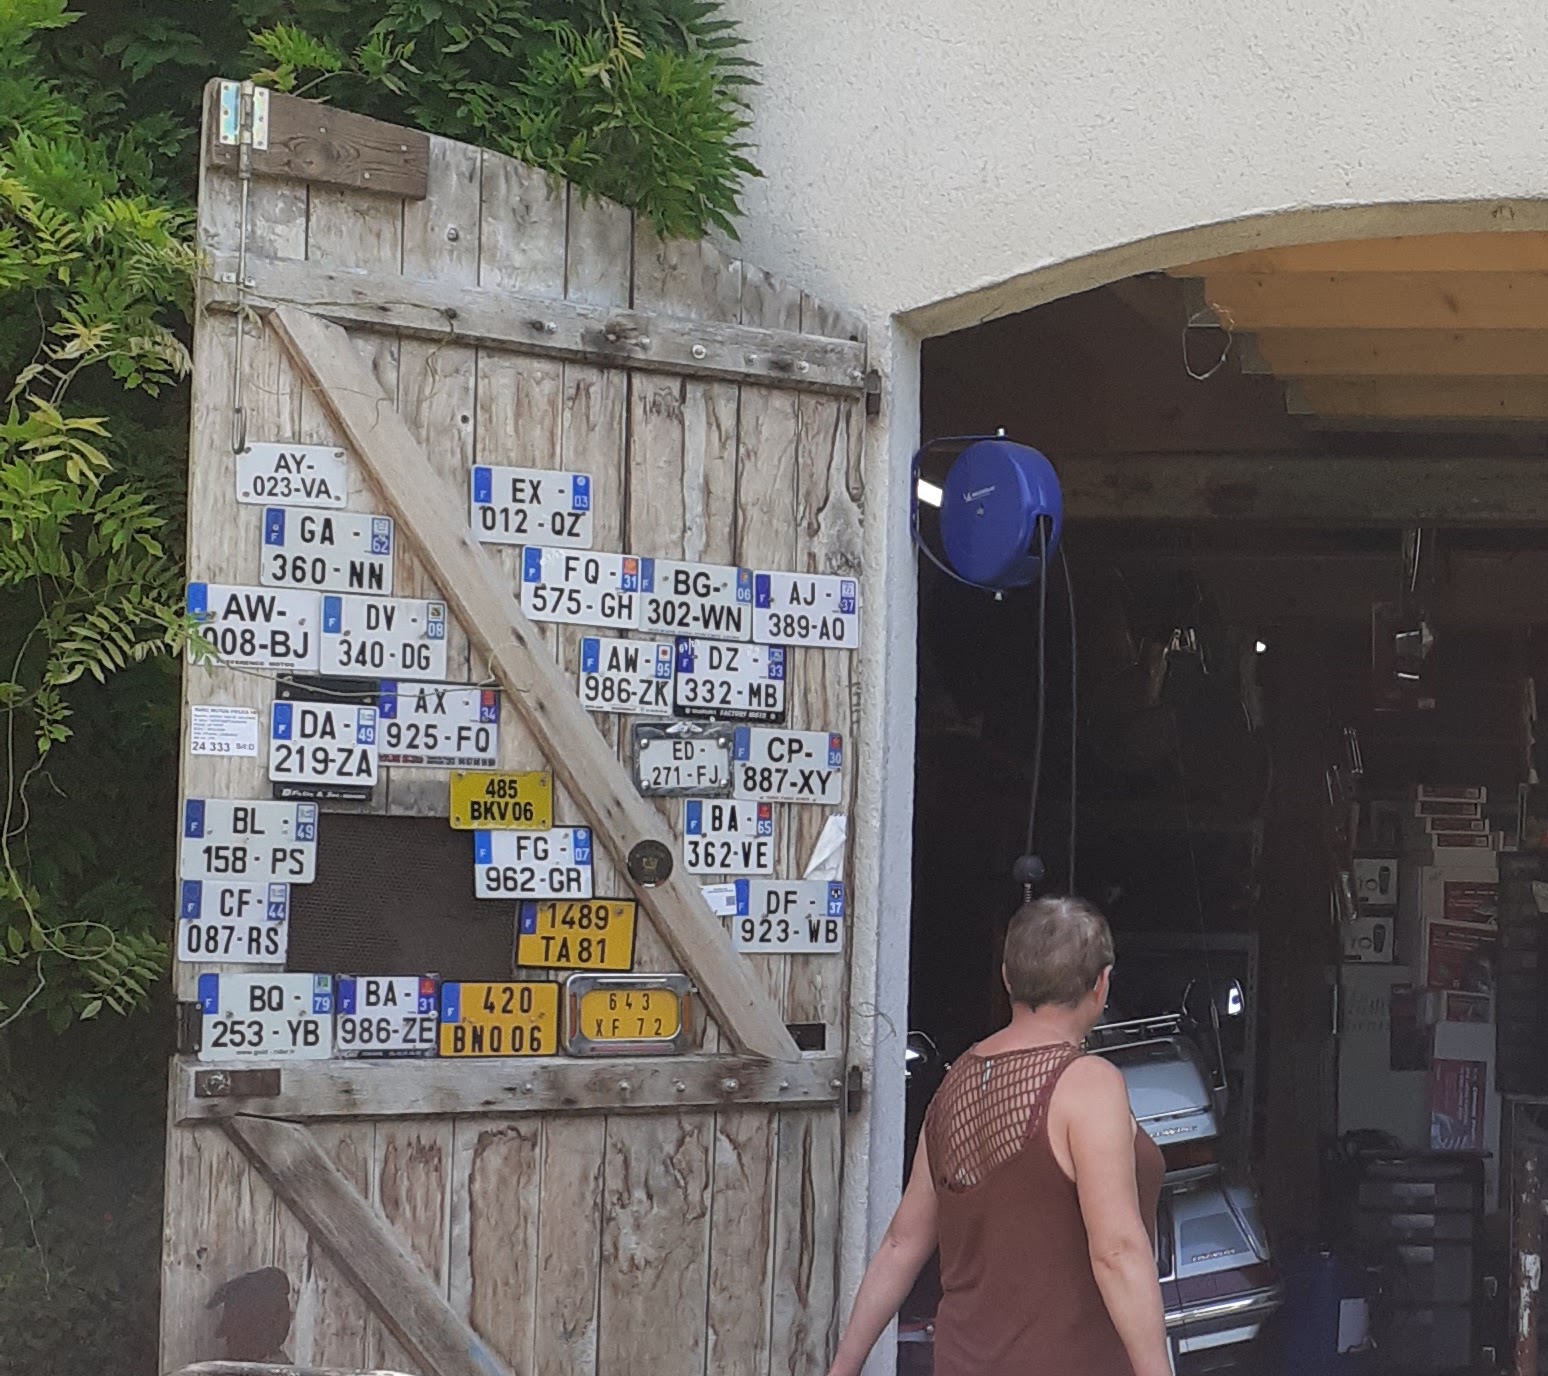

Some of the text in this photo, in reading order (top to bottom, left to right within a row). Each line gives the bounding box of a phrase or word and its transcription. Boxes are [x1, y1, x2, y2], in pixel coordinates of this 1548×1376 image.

[253, 475, 332, 500] 023-VA
[574, 495, 589, 508] 03
[481, 506, 582, 538] 012-QZ
[372, 539, 389, 553] 62
[271, 553, 384, 590] 360-NN
[623, 575, 637, 589] 31
[737, 587, 751, 601] 06
[759, 594, 766, 603] F
[532, 585, 633, 621] 575-GH
[842, 599, 855, 612] 37
[328, 617, 336, 626] F
[647, 598, 742, 633] 302-WN
[338, 638, 431, 671] 340-DG
[586, 658, 594, 667] F
[682, 658, 689, 668] F
[657, 663, 671, 677] 95
[769, 664, 784, 677] 33
[585, 675, 668, 707] 986-ZK
[684, 677, 778, 708] 332-MB
[481, 706, 496, 720] 34
[277, 724, 287, 735] F
[358, 727, 375, 742] 49
[737, 747, 745, 757] F
[829, 752, 842, 765] 30
[274, 743, 373, 778] 219-ZA
[652, 764, 718, 786] 271-FJ
[743, 766, 832, 796] 887-XY
[485, 778, 518, 800] 485
[190, 821, 198, 832] F
[690, 820, 698, 829] F
[757, 820, 772, 834] 65
[297, 825, 314, 840] 49
[202, 845, 305, 876] 158-PS
[575, 847, 591, 861] 07
[688, 840, 768, 869] 362-VE
[485, 866, 582, 893] 962-GR
[187, 902, 195, 913] F
[268, 904, 285, 919] 44
[829, 902, 842, 914] 37
[547, 902, 609, 931] 1489
[187, 924, 279, 956] 087-RS
[205, 998, 213, 1008] F
[314, 997, 331, 1011] 79
[343, 998, 351, 1009] F
[419, 997, 435, 1011] 31
[482, 986, 533, 1015] 420
[447, 1007, 455, 1017] F
[210, 1019, 320, 1048] 253-YB
[341, 1016, 435, 1044] 986-ZE
